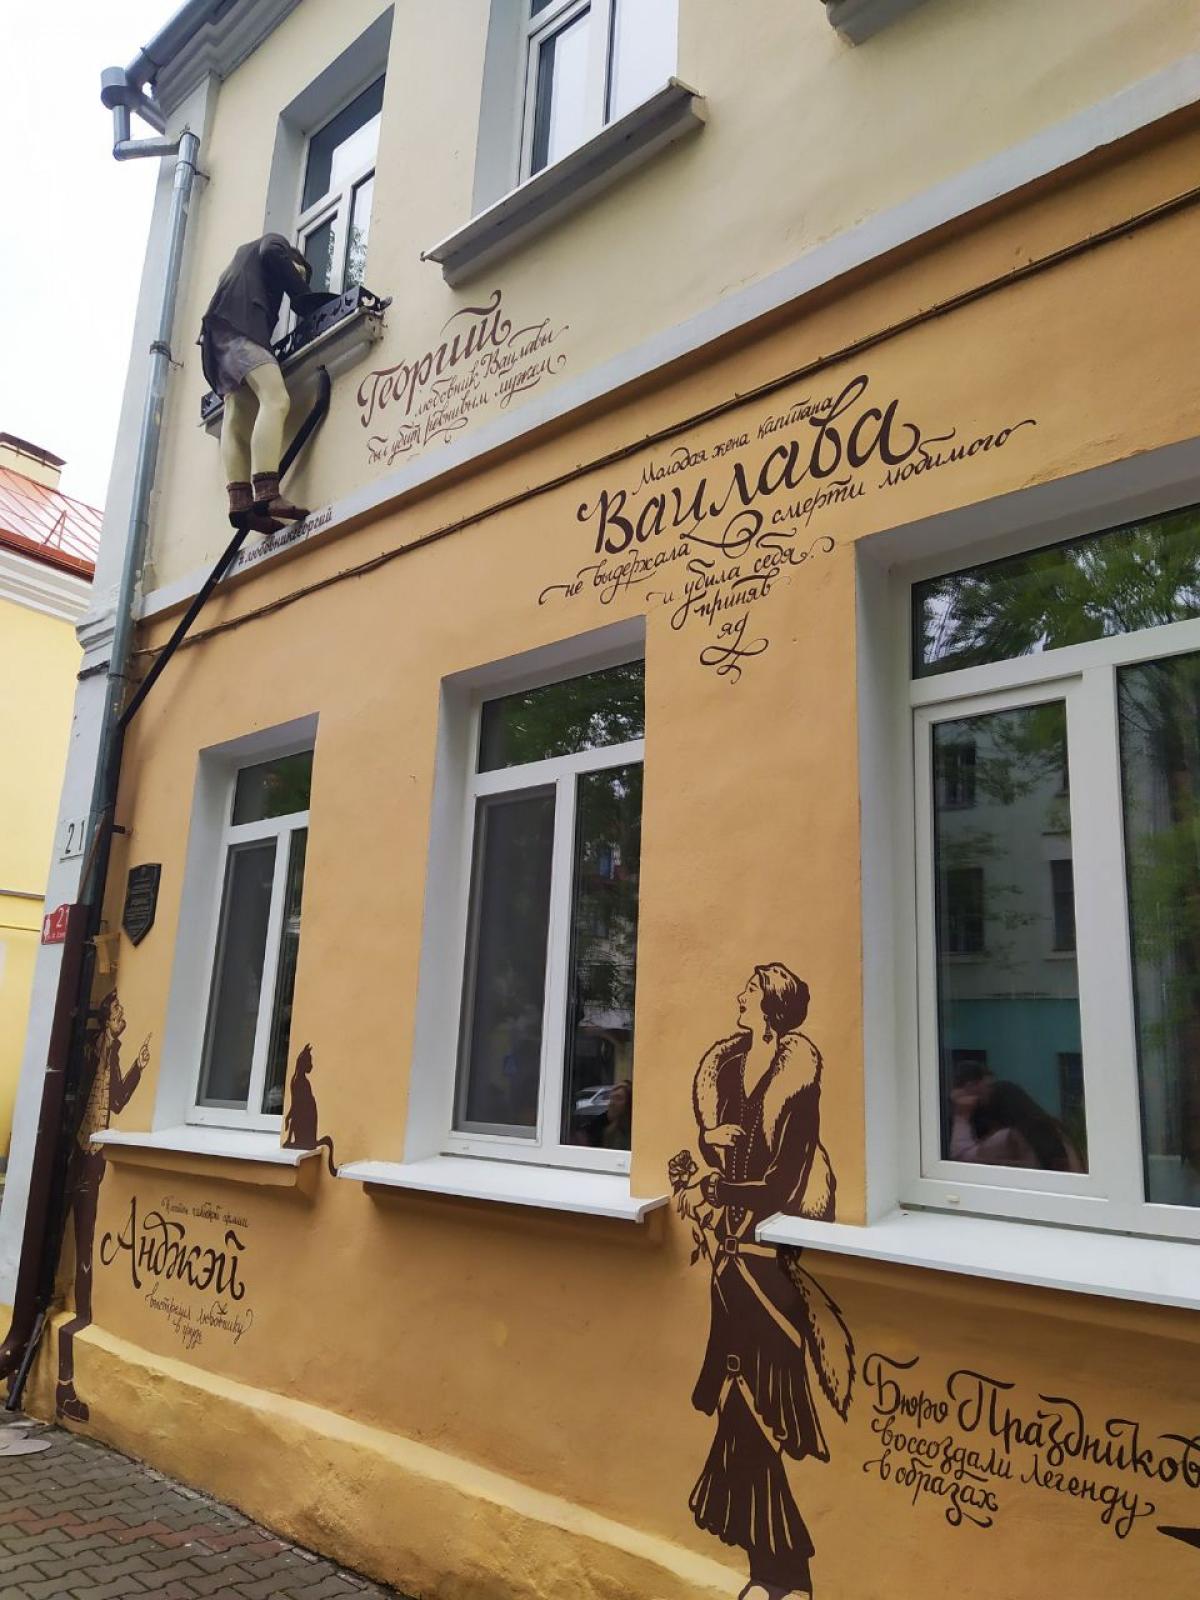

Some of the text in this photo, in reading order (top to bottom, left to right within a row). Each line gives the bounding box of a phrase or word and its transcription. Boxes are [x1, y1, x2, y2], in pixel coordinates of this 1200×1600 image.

[357, 289, 512, 428] Георгий
[415, 318, 569, 417] любовник Вацлавы
[494, 354, 567, 409] мужем
[577, 375, 920, 558] Вацлава
[633, 395, 835, 495] Молодая жена капитана
[588, 541, 690, 606] выдержала
[772, 475, 866, 528] смерти
[878, 420, 1036, 490] любимого
[671, 558, 742, 631] убила
[753, 529, 816, 574] себя
[693, 568, 783, 630] приняв
[64, 820, 86, 854] 21
[100, 1195, 246, 1301] Анджэй
[862, 1353, 1200, 1488] Бюро Праздников
[871, 1415, 1013, 1483] воссоздали
[862, 1448, 999, 1528] в образах
